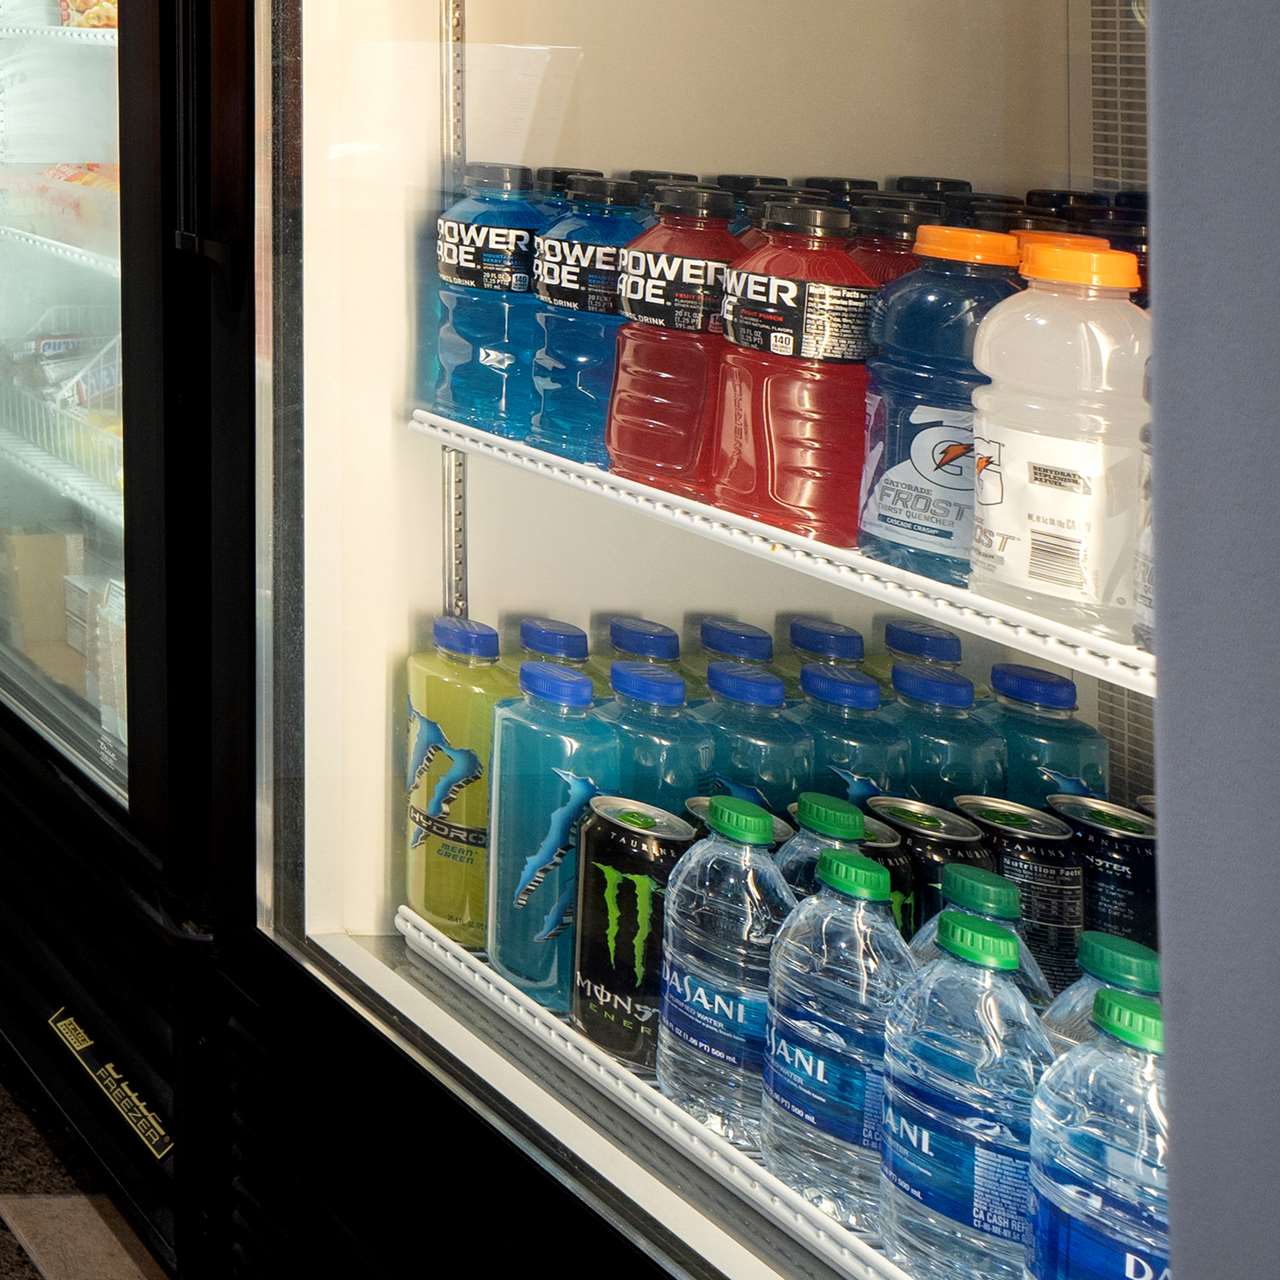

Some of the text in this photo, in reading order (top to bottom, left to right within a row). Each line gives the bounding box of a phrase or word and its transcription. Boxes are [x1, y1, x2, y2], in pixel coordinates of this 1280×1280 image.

[438, 219, 530, 251] POWER
[453, 278, 476, 287] DRINK
[841, 289, 860, 298] Facts
[553, 299, 578, 310] DRINK
[639, 317, 665, 326] DRINK
[774, 334, 790, 346] 140
[884, 479, 932, 495] GATORADE
[879, 485, 973, 521] FROST
[887, 517, 912, 528] CASCADE
[906, 511, 954, 528] QUENCHER
[410, 808, 486, 843] HYDRO
[1003, 857, 1049, 875] Nutrition
[662, 960, 746, 1024] DASANI
[712, 1048, 725, 1059] 500
[726, 1055, 737, 1064] mL
[96, 1068, 159, 1144] FREEZER
[791, 1105, 816, 1125] 500 mL
[897, 1178, 923, 1200] 500 mL
[973, 1207, 1010, 1229] CA CASH
